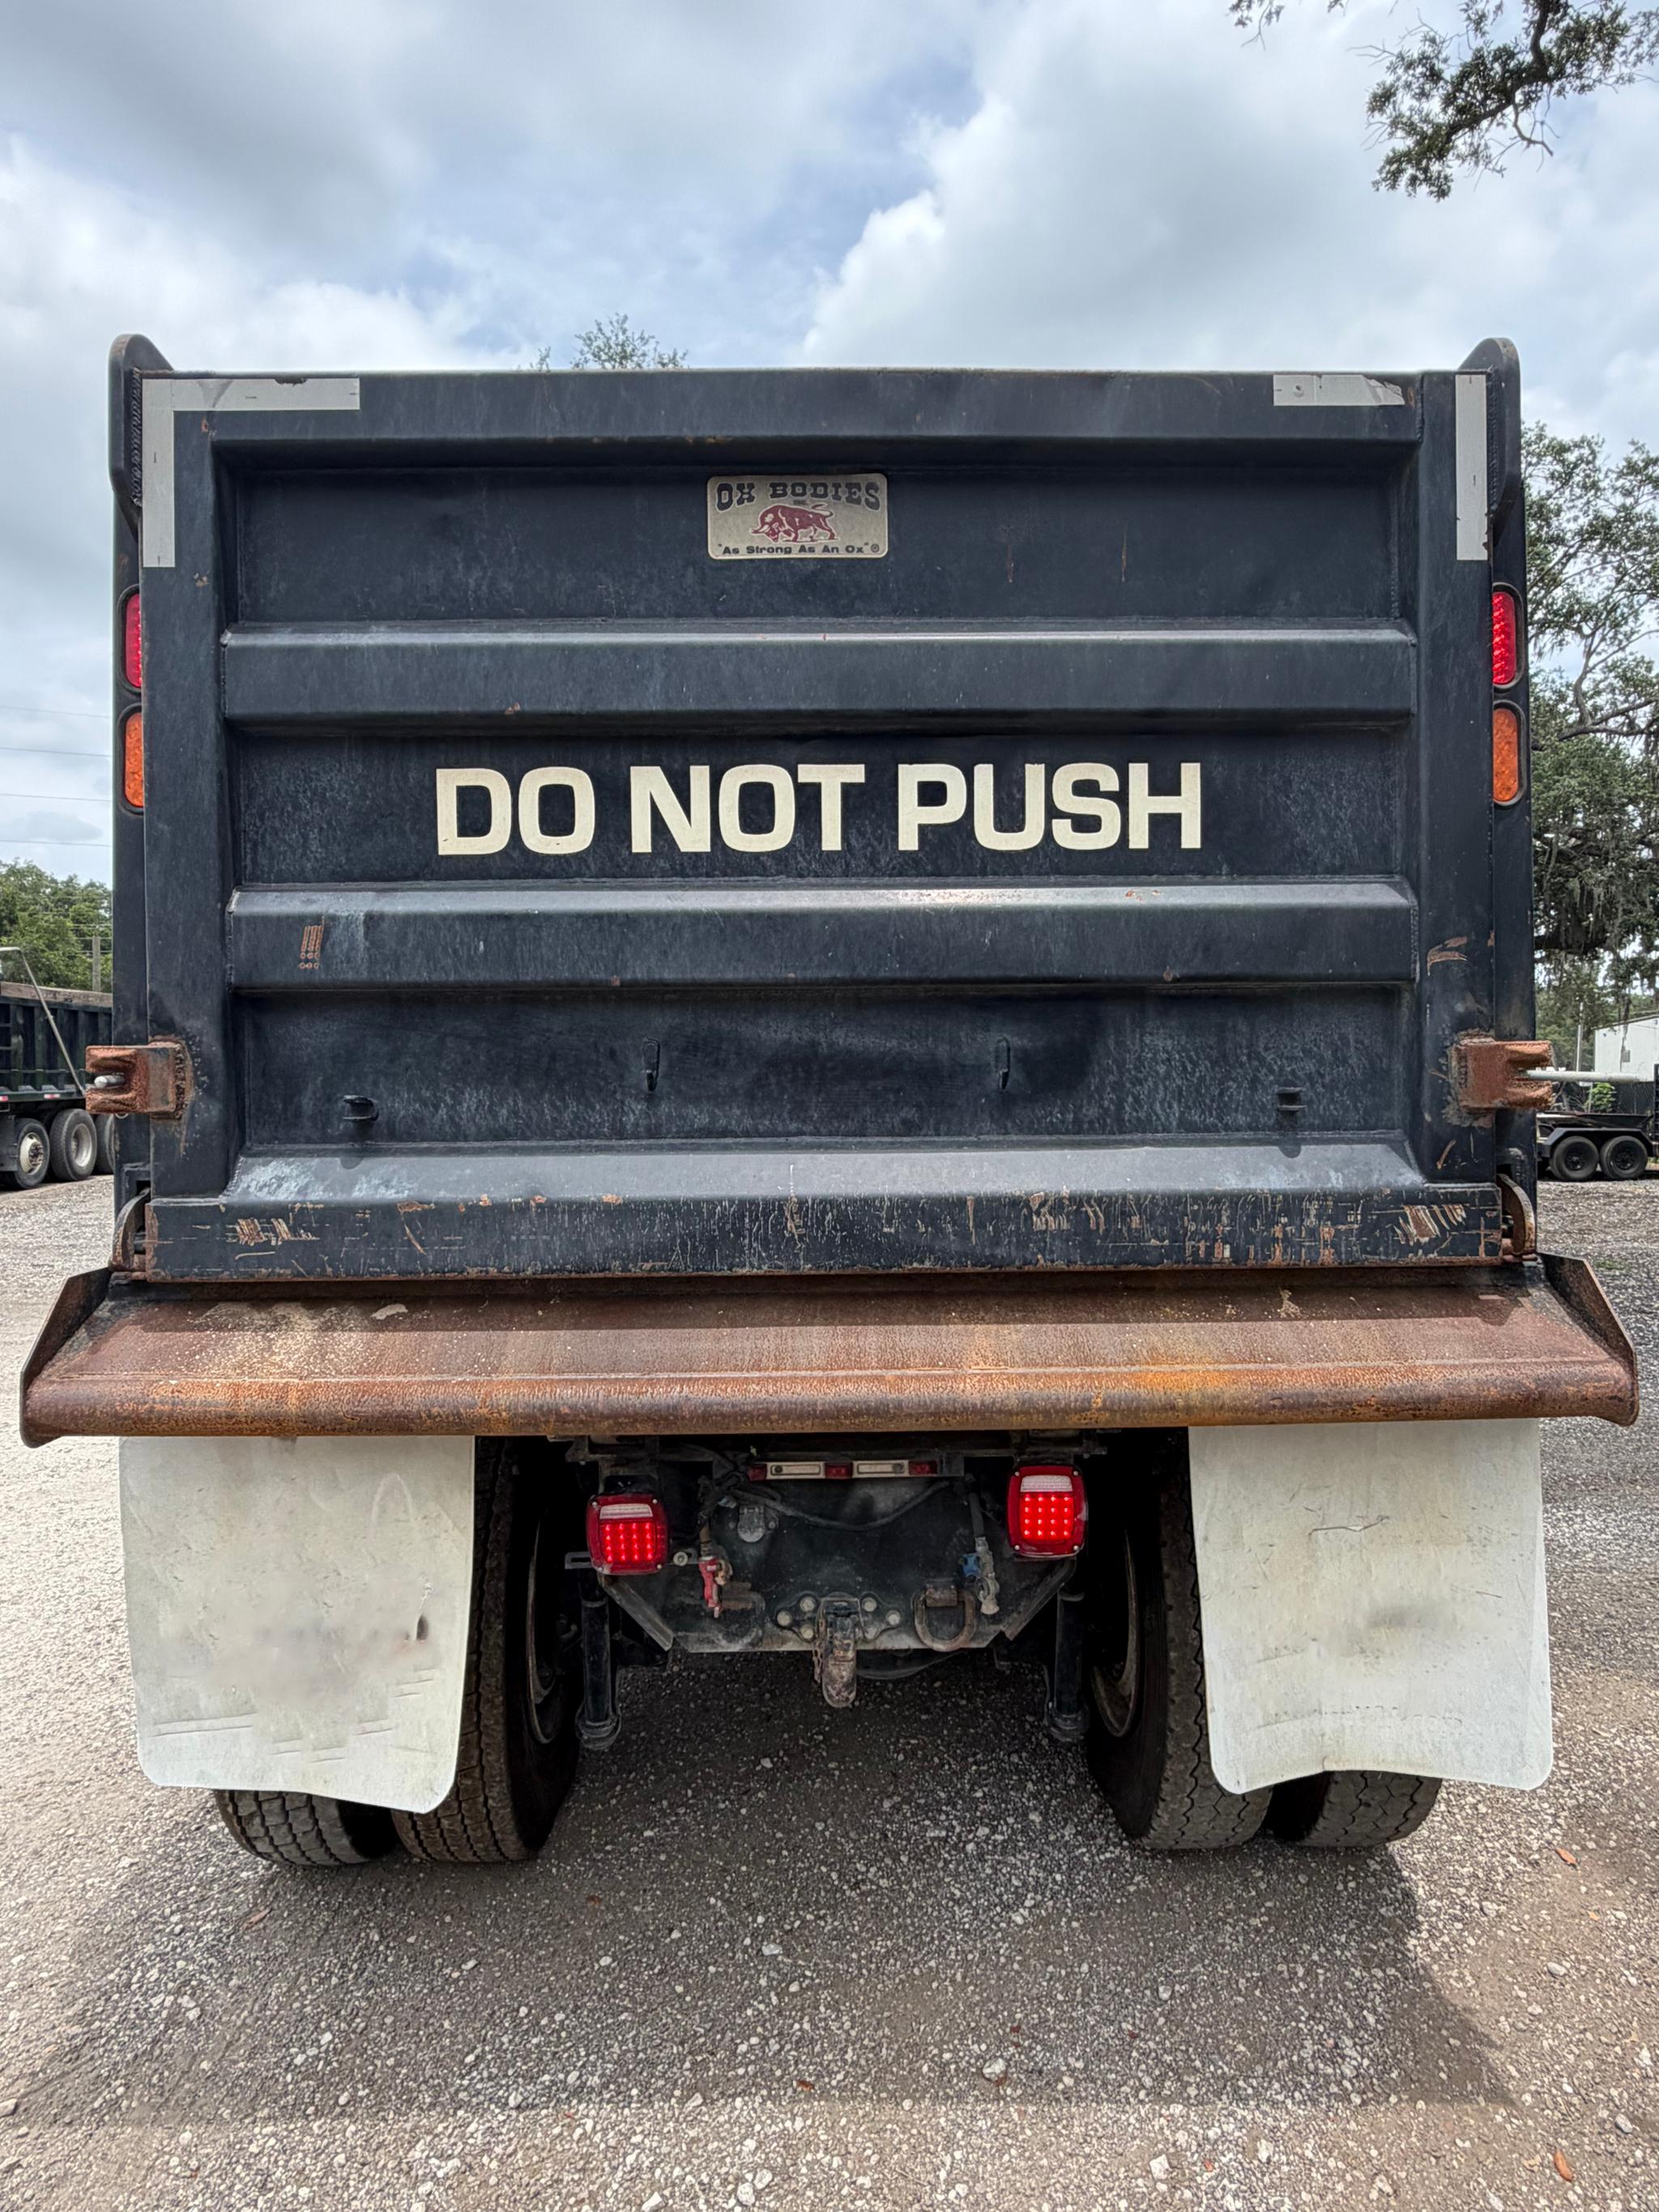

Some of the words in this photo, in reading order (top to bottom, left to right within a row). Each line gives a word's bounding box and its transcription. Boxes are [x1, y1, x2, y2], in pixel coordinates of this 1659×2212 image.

[716, 483, 756, 511] OX
[770, 481, 881, 510] BODIES
[745, 545, 792, 555] Strong
[798, 544, 816, 554] As
[821, 544, 839, 554] An
[436, 766, 595, 855] DO
[630, 764, 865, 853] NOT
[898, 762, 1201, 850] PUSH
